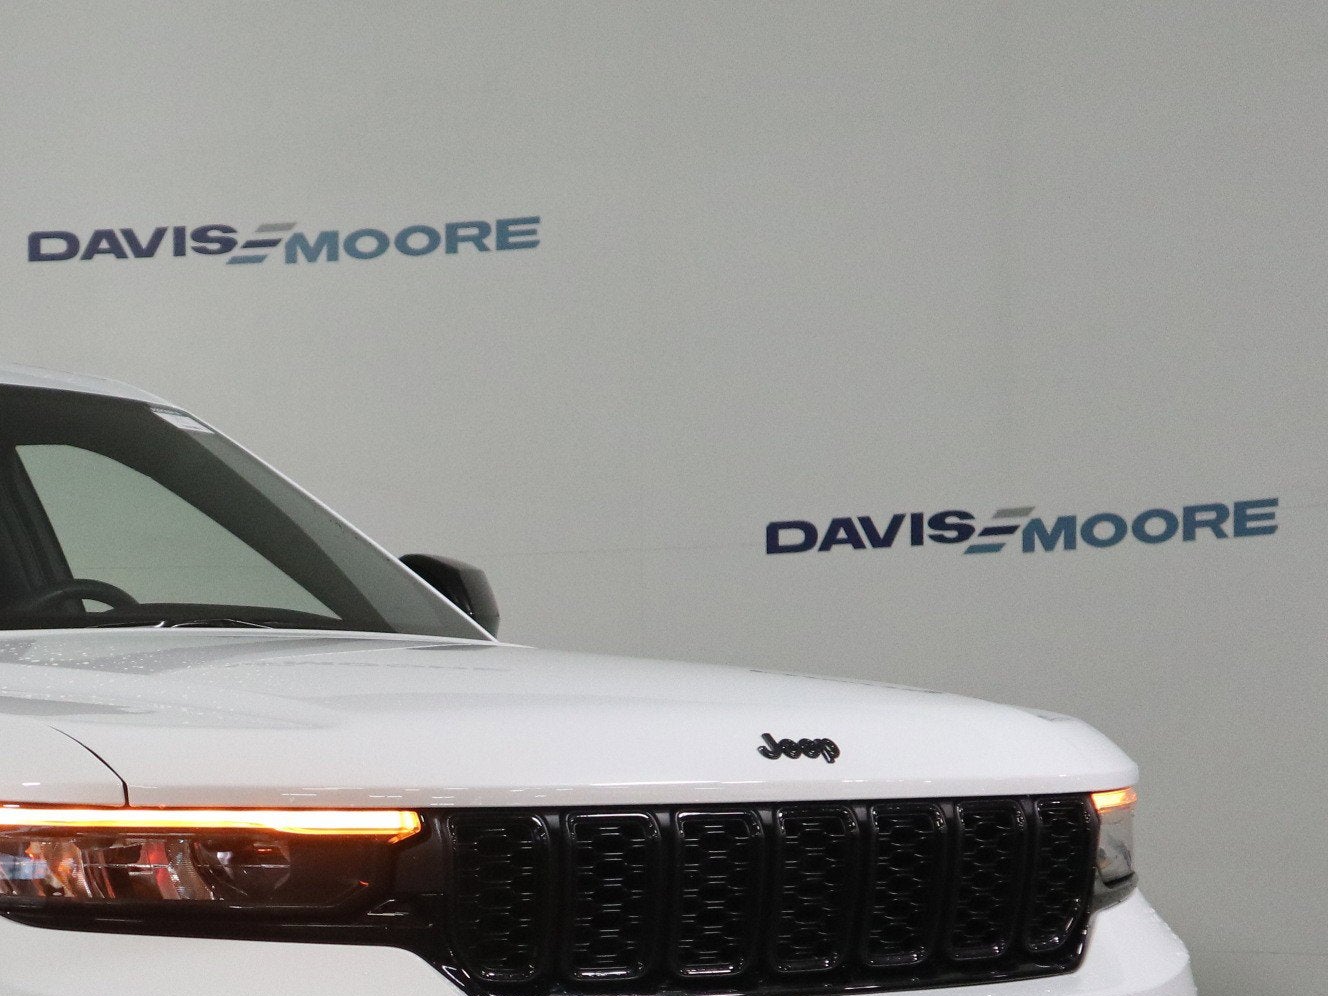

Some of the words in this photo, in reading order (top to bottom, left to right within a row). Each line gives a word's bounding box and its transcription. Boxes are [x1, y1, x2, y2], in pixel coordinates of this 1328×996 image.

[27, 224, 239, 262] DAVIS
[284, 216, 541, 265] MOORE
[765, 509, 977, 555] DAVIS
[1022, 498, 1279, 554] MOORE
[757, 732, 841, 764] Jeep
